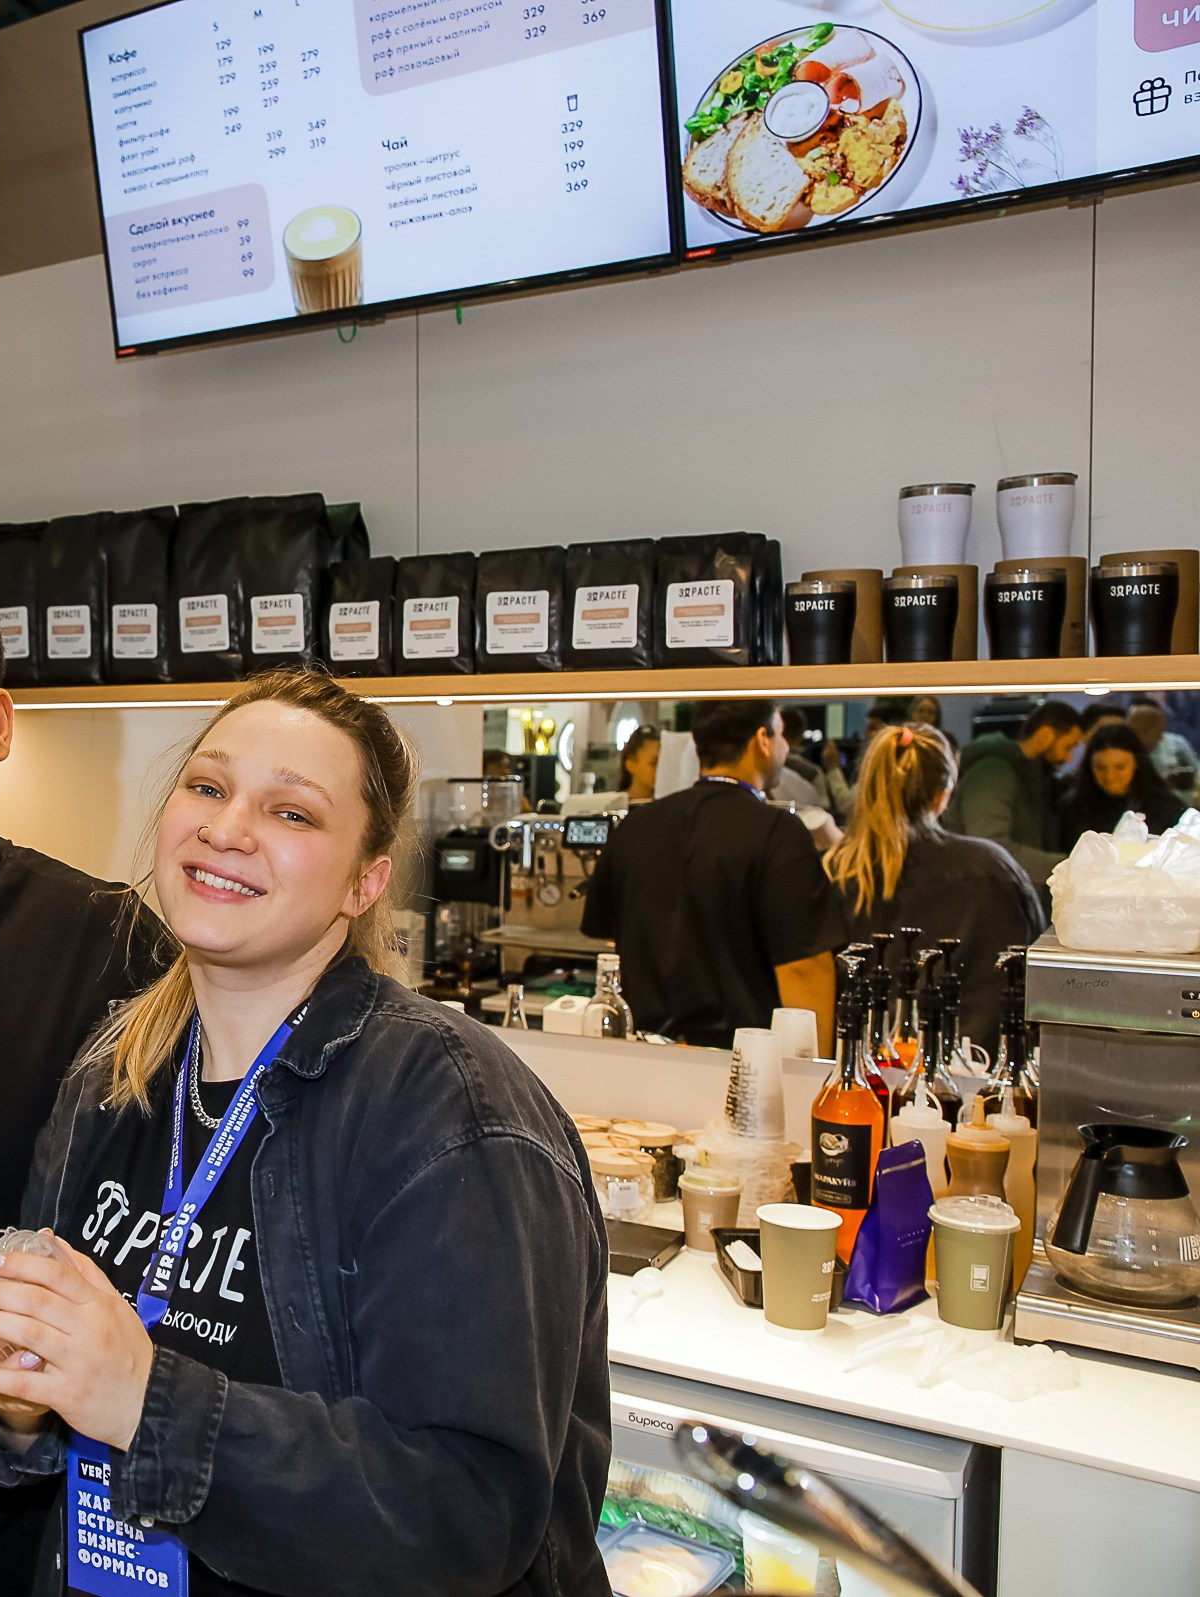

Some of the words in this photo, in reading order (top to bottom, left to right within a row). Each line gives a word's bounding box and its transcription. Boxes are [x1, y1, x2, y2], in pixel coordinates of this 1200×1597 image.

[213, 22, 219, 32] S
[253, 9, 263, 19] M
[371, 28, 392, 44] раф
[450, 1, 503, 21] арахисом
[216, 39, 232, 51] 129
[372, 46, 394, 62] раф
[443, 21, 491, 41] малиной
[523, 5, 545, 20] 329
[108, 49, 138, 65] Кофе
[218, 56, 233, 67] 179
[258, 44, 275, 56] 199
[374, 66, 395, 82] раф
[525, 25, 547, 40] 329
[582, 9, 606, 25] 369
[219, 73, 236, 85] 229
[259, 61, 277, 73] 259
[302, 49, 319, 62] 279
[261, 78, 279, 91] 259
[303, 66, 321, 79] 279
[223, 106, 239, 118] 199
[263, 96, 279, 108] 219
[224, 123, 242, 136] 249
[561, 120, 583, 134] 329
[178, 153, 196, 166] раф
[266, 130, 283, 142] 319
[308, 118, 327, 131] 349
[268, 146, 286, 159] 299
[310, 136, 327, 149] 319
[381, 137, 408, 151] Чай
[424, 166, 471, 184] листовой
[564, 140, 584, 153] 199
[431, 183, 478, 202] листовой
[565, 160, 586, 173] 199
[565, 179, 588, 194] 369
[129, 217, 169, 237] Сделай
[172, 208, 216, 229] вкуснее
[237, 219, 250, 229] 99
[239, 235, 252, 246] 39
[241, 252, 253, 263] 69
[242, 268, 255, 278] 99
[894, 594, 938, 608] ЗДРАСТЕ
[998, 589, 1044, 603] ЗДРАСТЕ
[1110, 583, 1161, 597] ЗДРАСТЕ
[795, 599, 835, 612] ЗДРАСТЕ
[206, 1169, 216, 1182] НЕ
[214, 1136, 235, 1167] ВРЕДИТ
[233, 1096, 255, 1132] ВАШЕМУ
[150, 1202, 197, 1292] VERSOUS
[628, 1412, 674, 1431] бирюса
[80, 1462, 111, 1480] VERS
[77, 1490, 111, 1513] ЖАР
[77, 1510, 145, 1542] ВСТРЕЧА
[77, 1529, 141, 1559] БИЗНЕС-
[77, 1548, 169, 1589] ФОРМАТОВ
